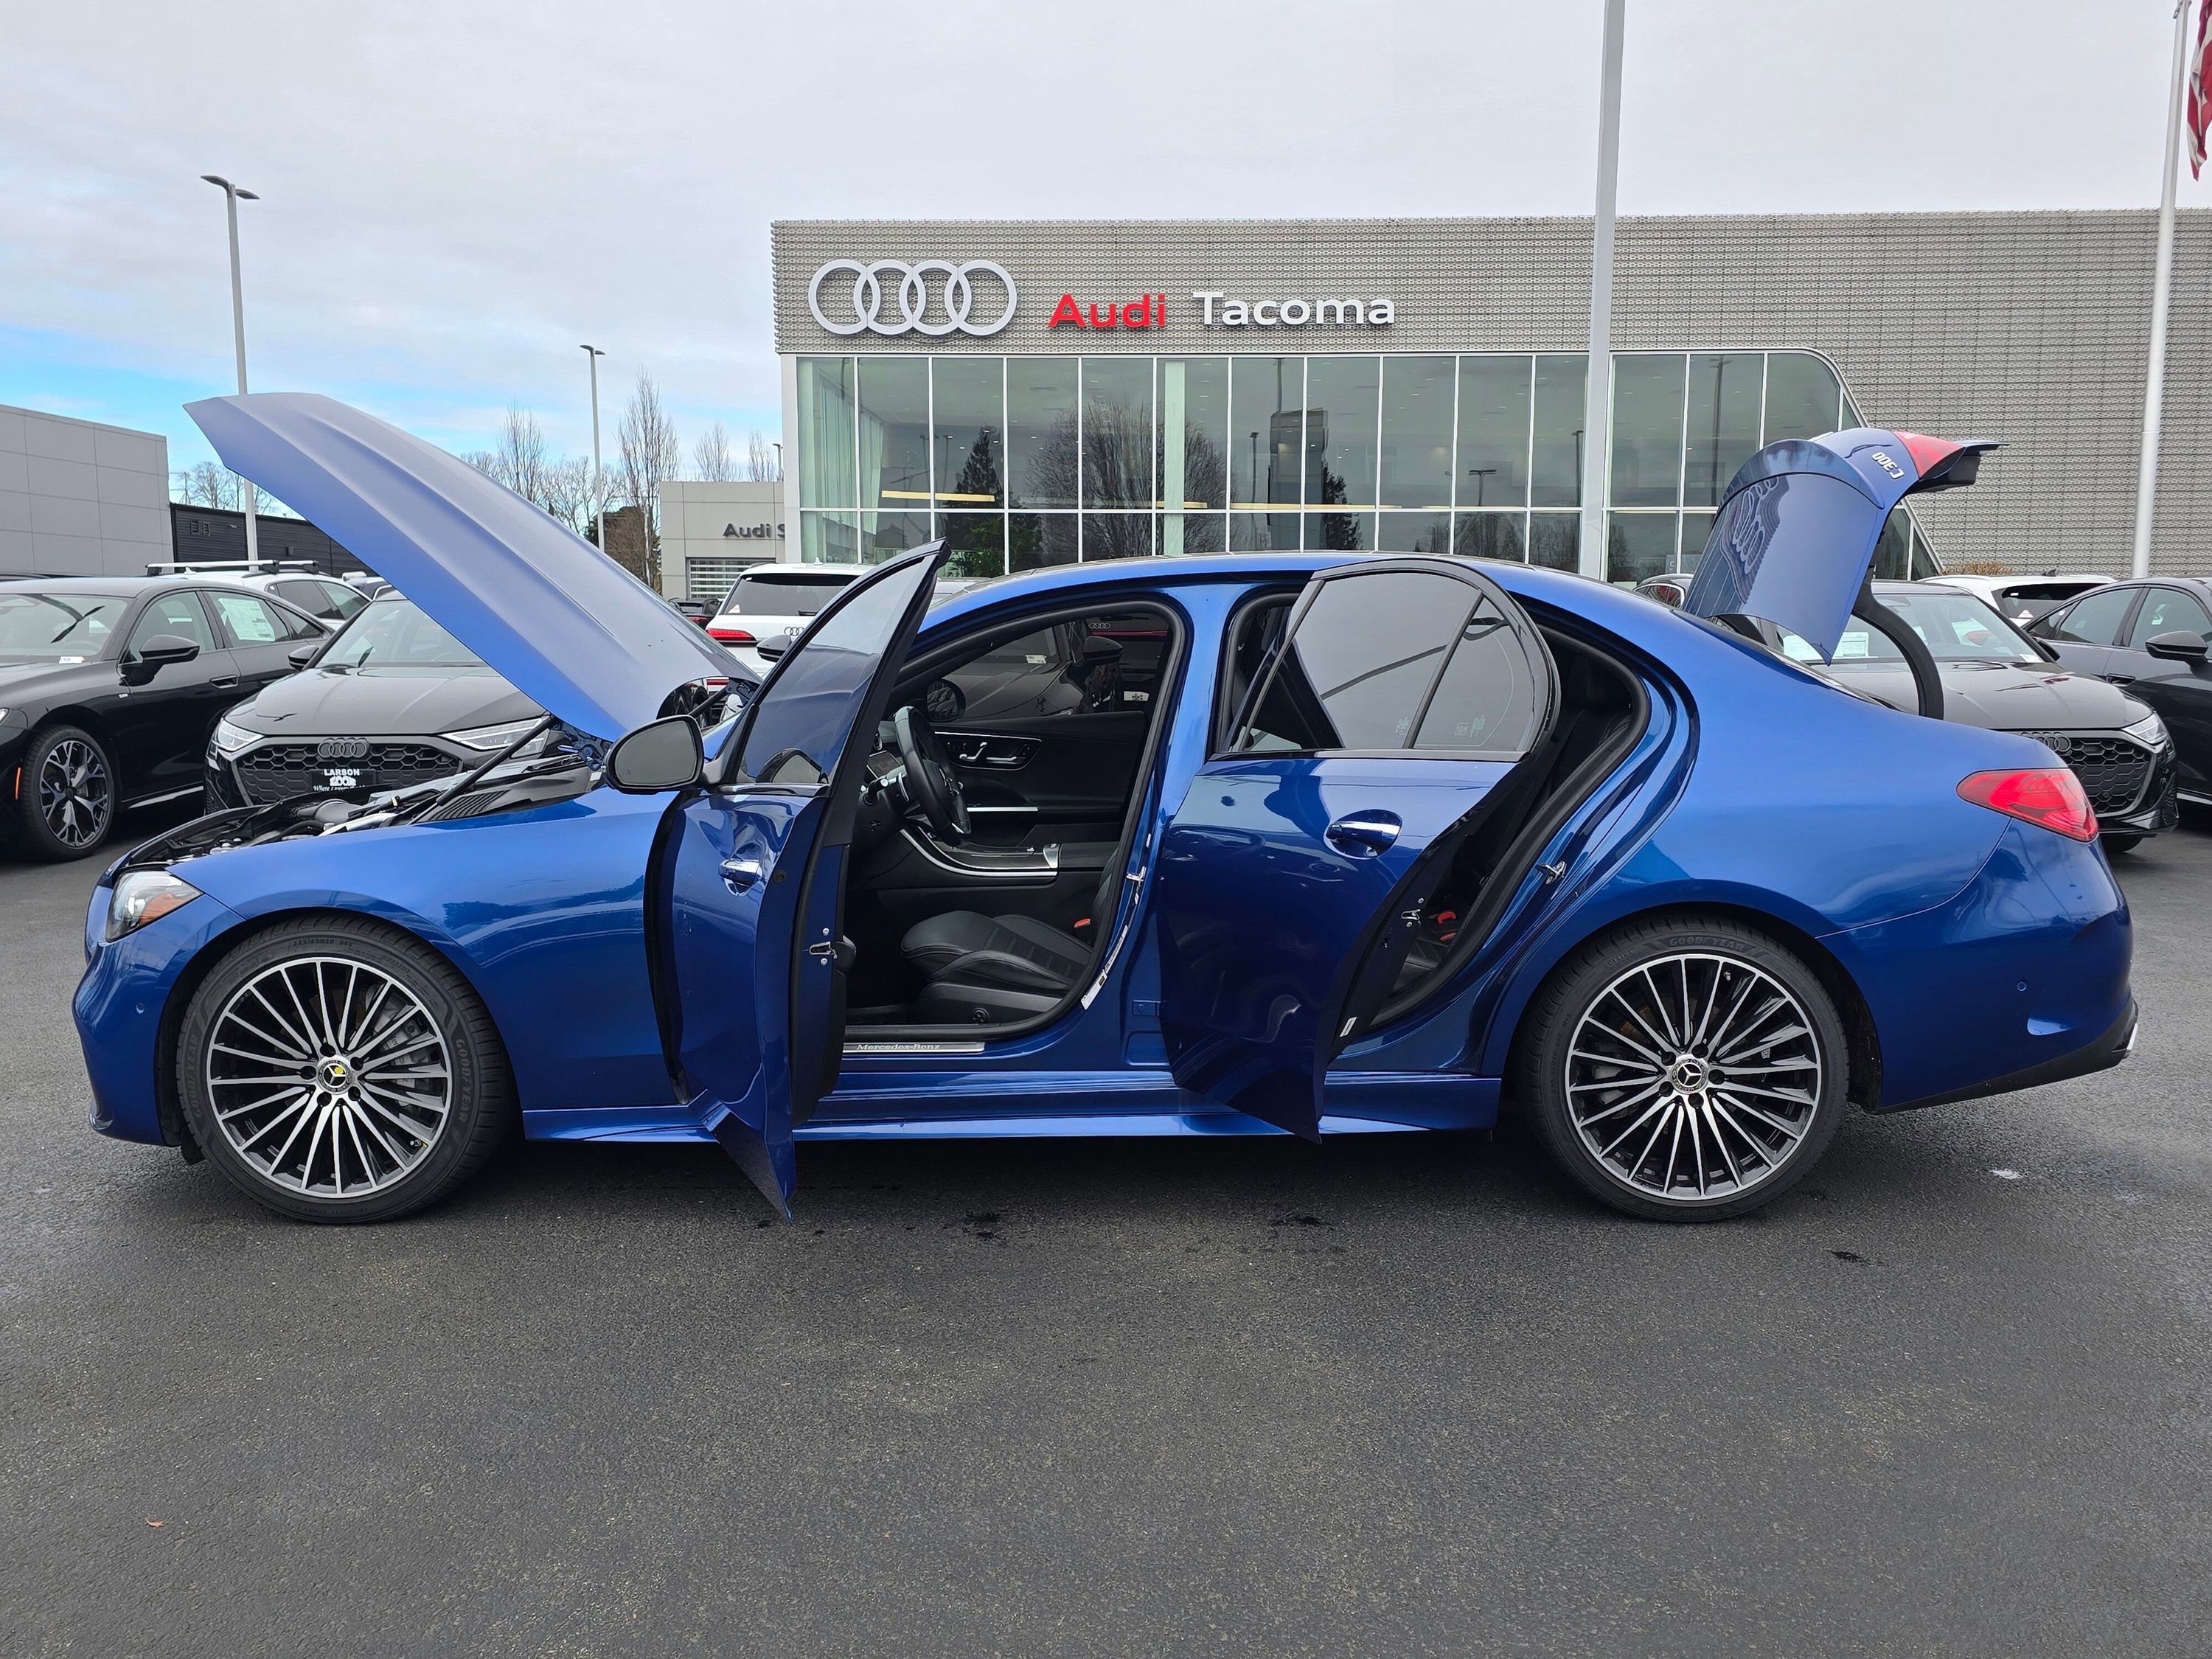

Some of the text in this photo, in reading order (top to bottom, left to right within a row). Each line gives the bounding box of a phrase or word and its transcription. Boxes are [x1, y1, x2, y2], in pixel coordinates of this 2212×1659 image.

[1048, 291, 1395, 328] Audi Tacoma
[1871, 451, 1905, 479] C300
[723, 523, 771, 538] Audi
[1669, 936, 1746, 950] GOODYEAR
[455, 1038, 472, 1123] GOODYEAR
